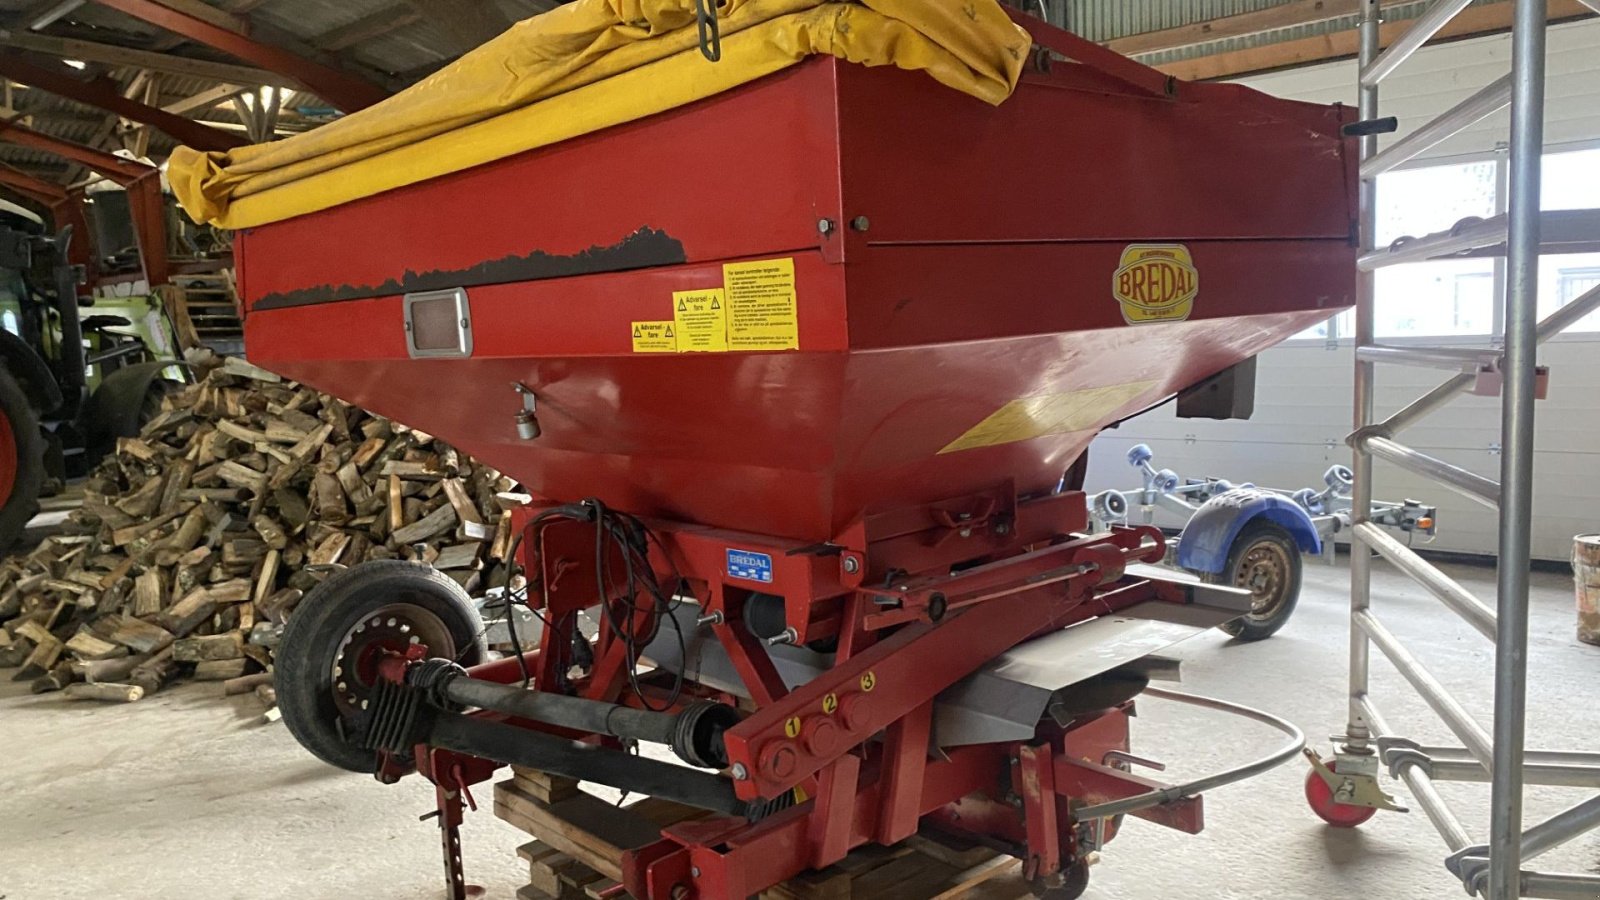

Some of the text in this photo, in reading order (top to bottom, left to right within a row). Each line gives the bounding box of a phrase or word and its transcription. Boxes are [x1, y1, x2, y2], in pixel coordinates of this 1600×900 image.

[1119, 263, 1194, 305] BREDAL
[729, 554, 769, 569] BREDAL
[788, 674, 873, 735] 1 2 3
